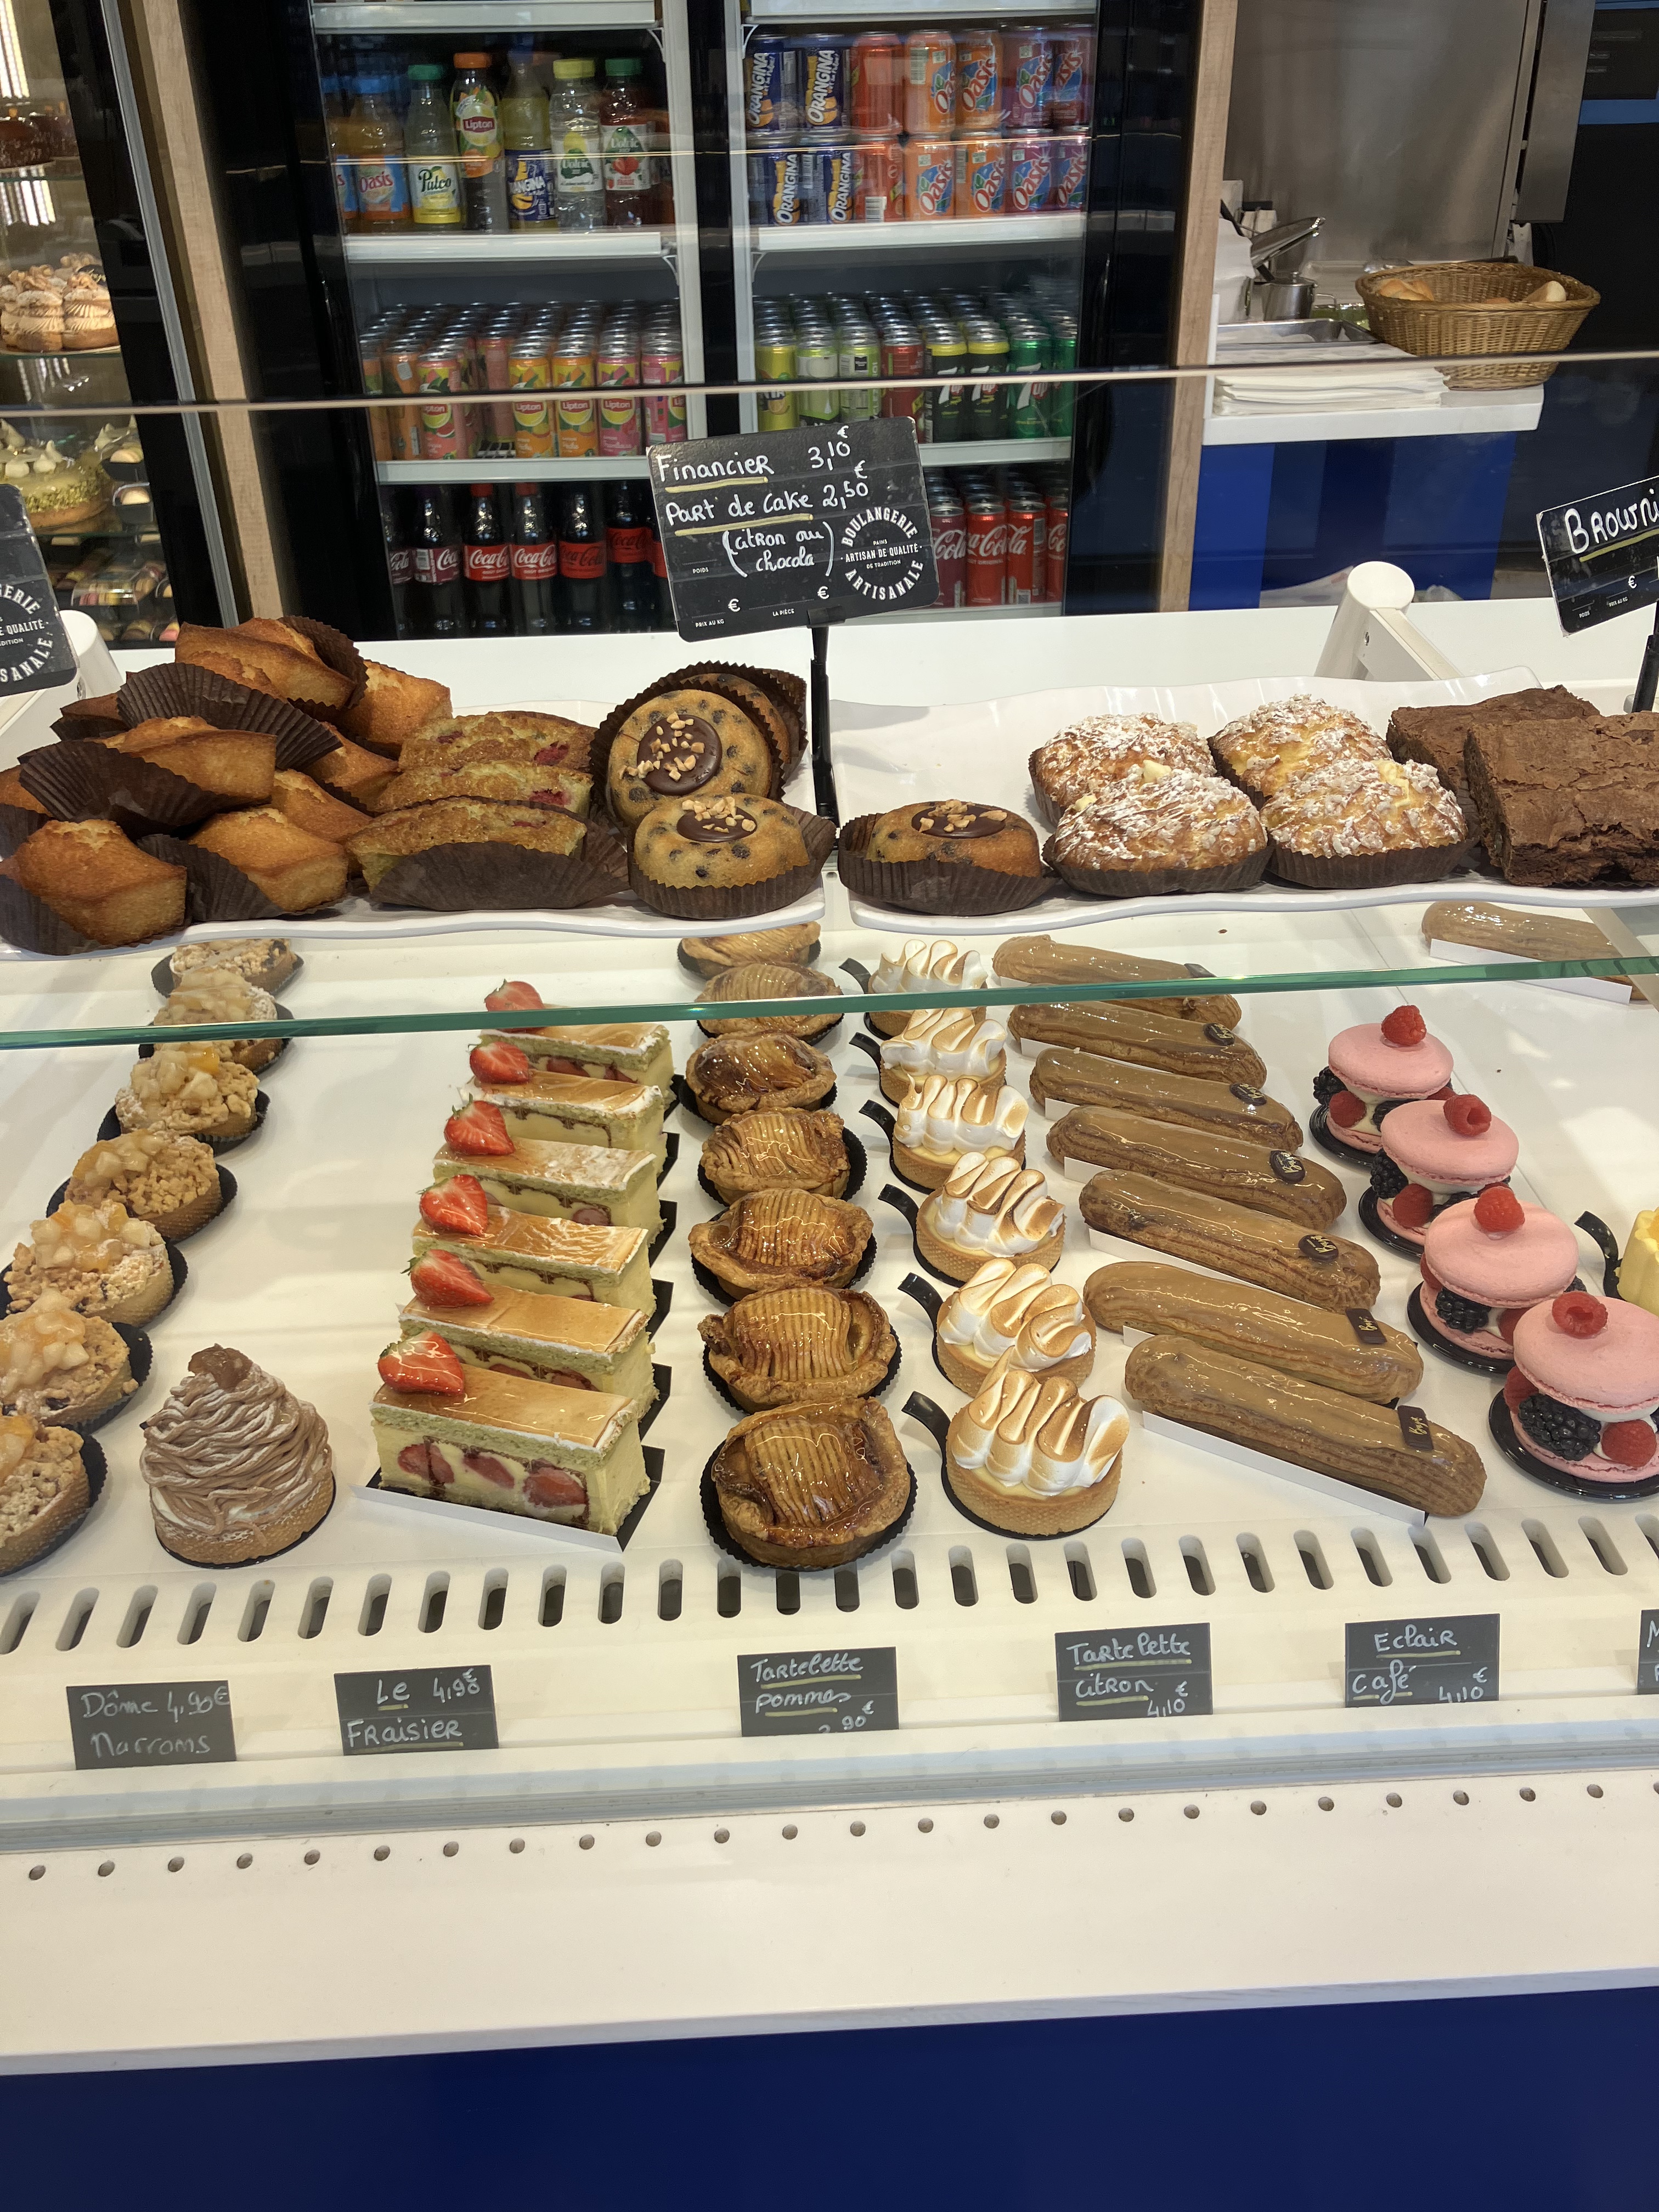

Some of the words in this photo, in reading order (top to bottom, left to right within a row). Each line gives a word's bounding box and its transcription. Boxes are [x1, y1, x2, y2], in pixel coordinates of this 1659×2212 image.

[808, 50, 835, 123] ORANGINA
[465, 120, 493, 130] Lipton
[359, 171, 394, 193] Oasis
[419, 168, 452, 192] Pulco
[776, 154, 798, 223] ORANGINA
[831, 153, 851, 221] ORANGINA
[919, 162, 953, 216] Oasis
[1013, 157, 1051, 211] Oasis
[517, 403, 542, 412] Lipton
[562, 402, 588, 410] Lipton
[605, 400, 631, 410] Lipton
[808, 441, 850, 471] 3,10
[728, 494, 755, 517] de
[823, 480, 868, 509] 2,50
[841, 506, 918, 548] BOULANGERIE
[845, 550, 876, 562] ARTISAN
[878, 549, 888, 558] DE
[889, 543, 918, 556] QUALITÉ
[874, 560, 901, 568] TRADITION
[845, 560, 924, 601] ARTISANALE
[1628, 575, 1637, 589] €
[728, 599, 741, 612] €
[817, 586, 830, 600] €
[6, 619, 45, 635] QUALITÉ
[376, 1679, 410, 1705] Le
